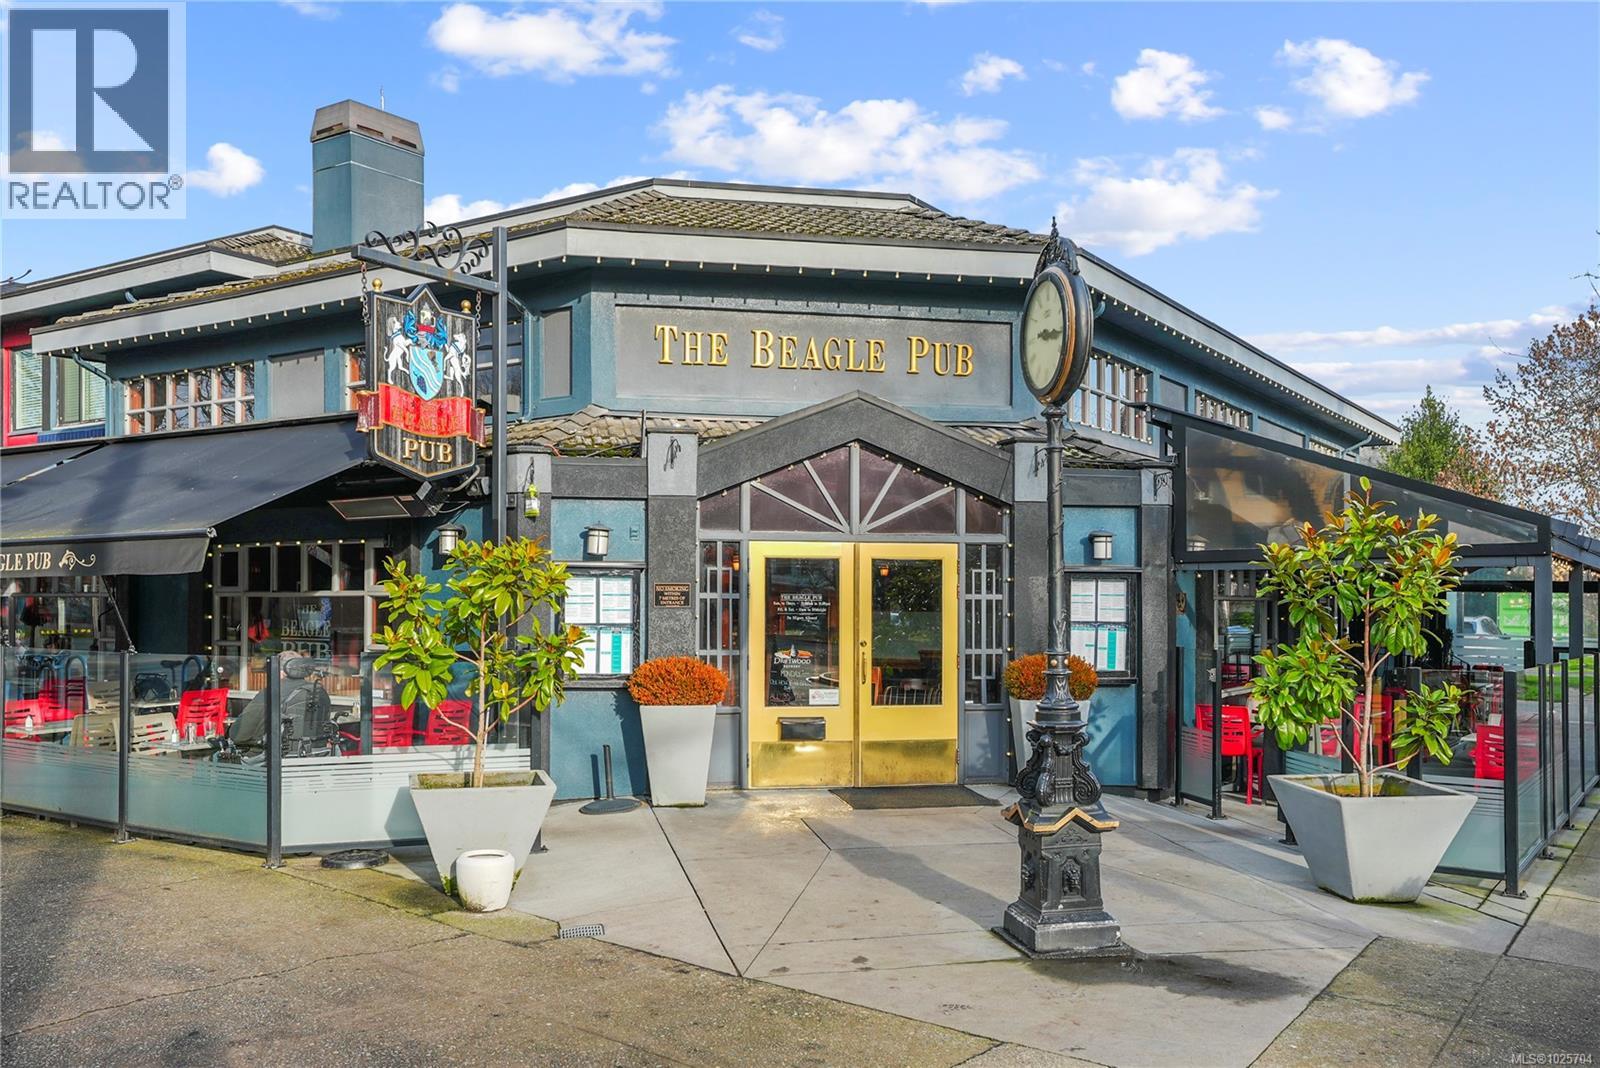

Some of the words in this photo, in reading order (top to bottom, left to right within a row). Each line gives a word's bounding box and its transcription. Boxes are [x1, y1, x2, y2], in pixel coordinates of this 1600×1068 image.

[654, 324, 729, 367] THE
[751, 329, 886, 373] BEAGLE
[907, 335, 975, 378] PUB
[402, 437, 453, 463] PUB
[26, 551, 52, 570] PUB
[281, 619, 331, 638] BEAGLE
